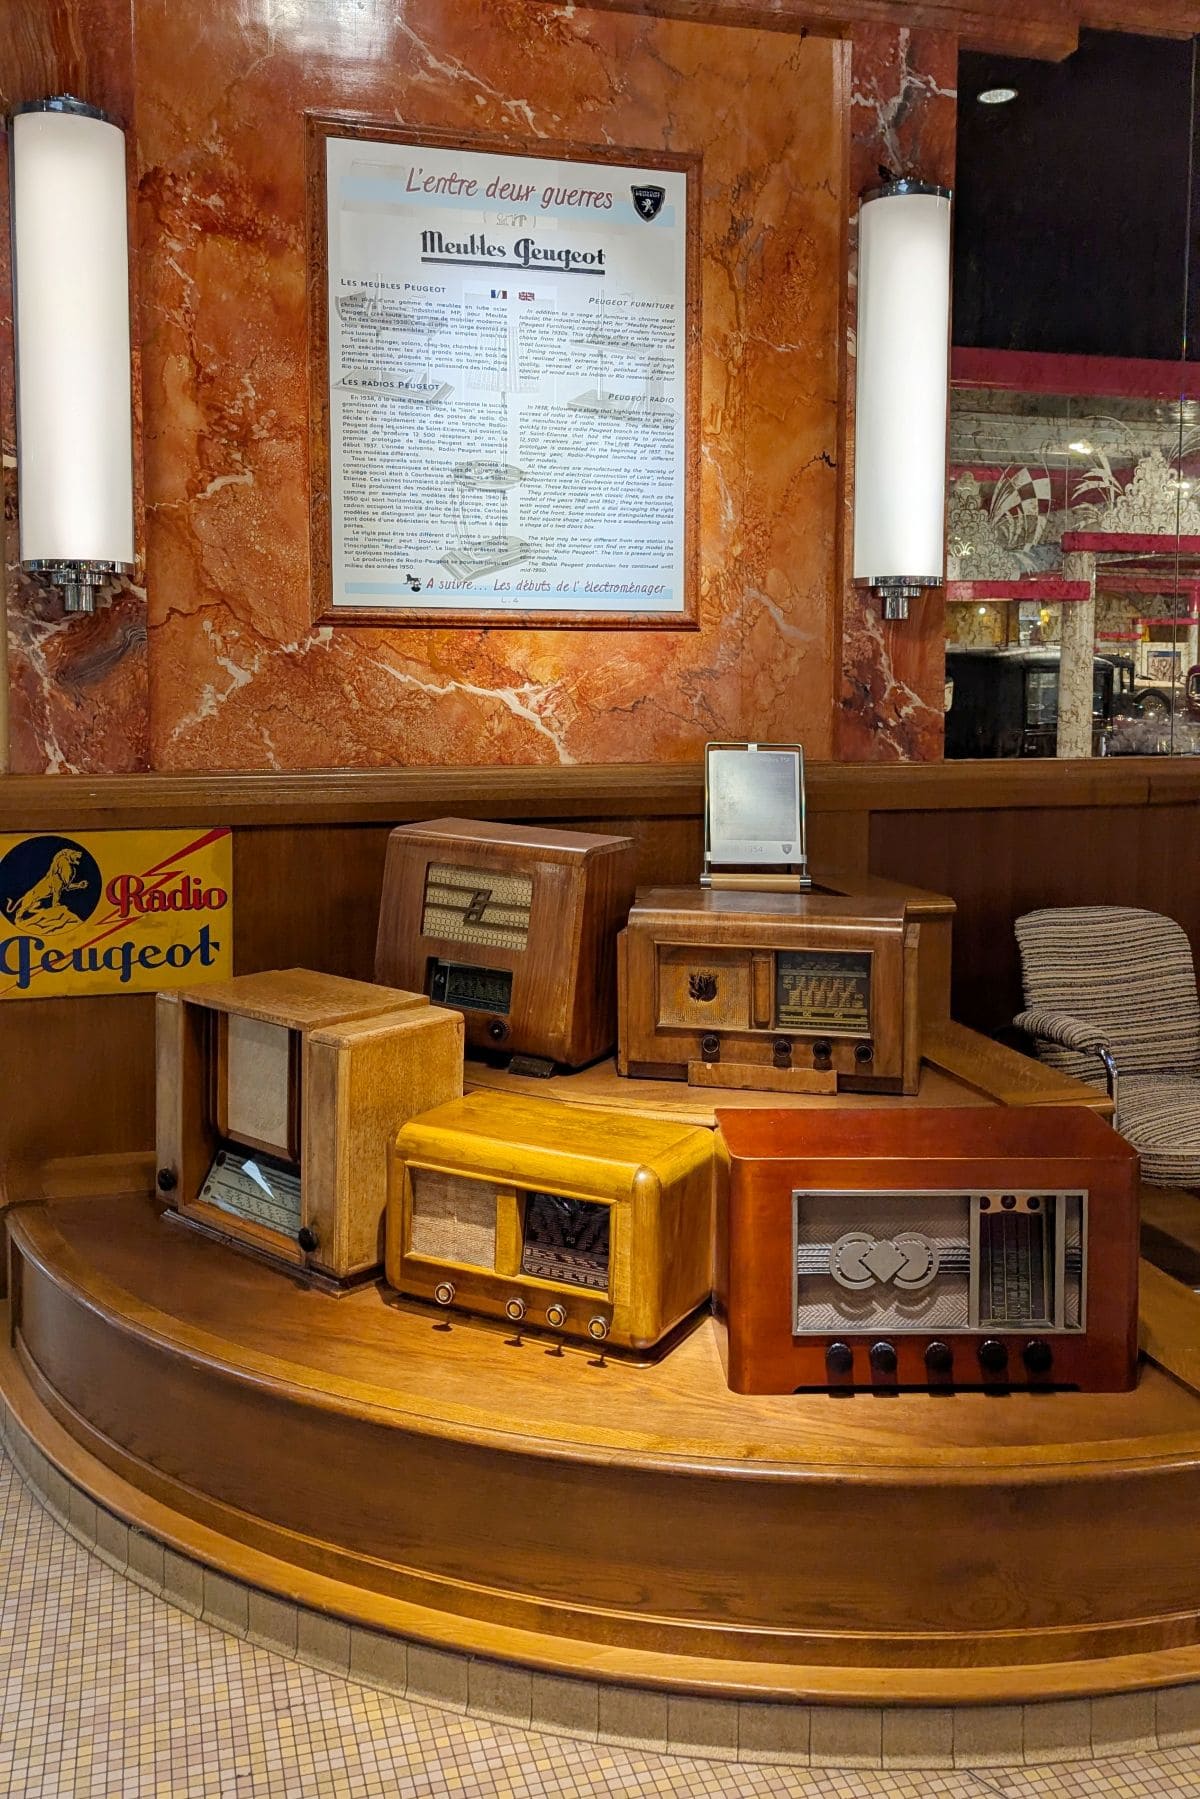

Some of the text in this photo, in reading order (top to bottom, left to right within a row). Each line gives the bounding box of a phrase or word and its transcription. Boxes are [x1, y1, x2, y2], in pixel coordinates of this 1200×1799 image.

[405, 167, 614, 210] L'entre deux guerres
[420, 230, 606, 269] Meubles Peugeot
[426, 577, 433, 588] A
[493, 579, 510, 591] Les
[556, 580, 569, 592] de
[106, 874, 228, 918] Radio
[0, 924, 220, 989] Peugeot
